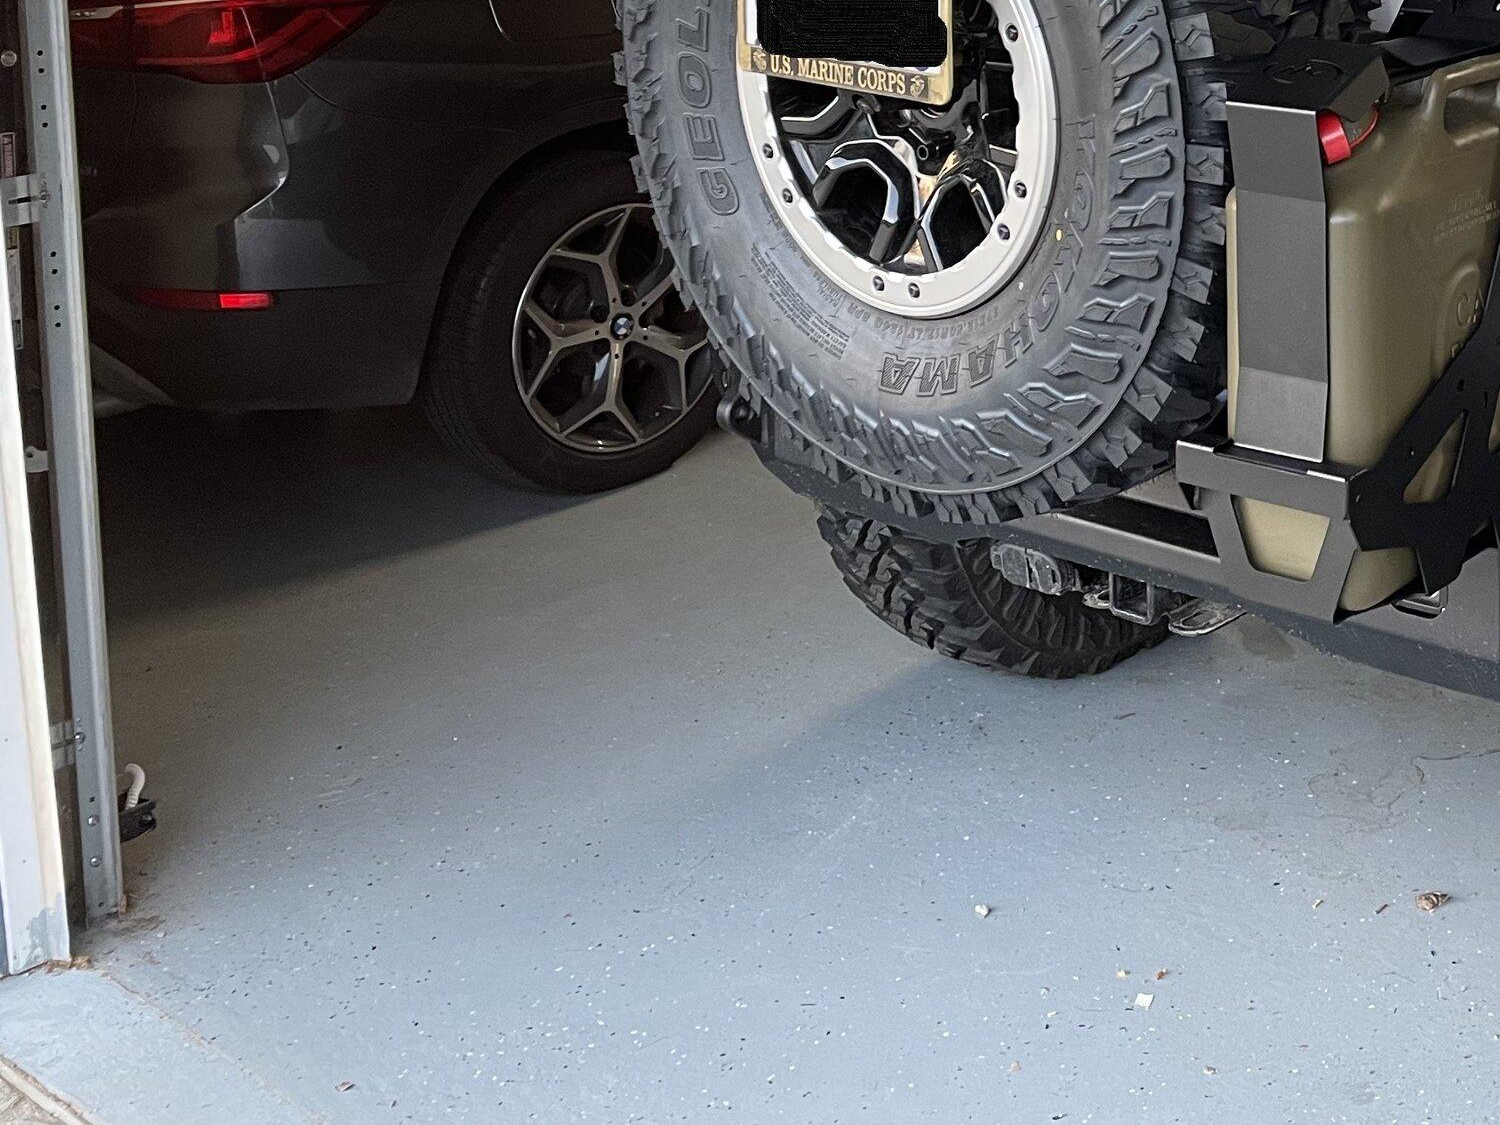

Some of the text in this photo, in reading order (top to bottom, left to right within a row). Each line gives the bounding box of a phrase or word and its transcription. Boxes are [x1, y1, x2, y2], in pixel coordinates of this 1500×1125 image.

[769, 53, 907, 96] U.S. MARINE CORPS
[877, 111, 1099, 398] YOKOHAMA
